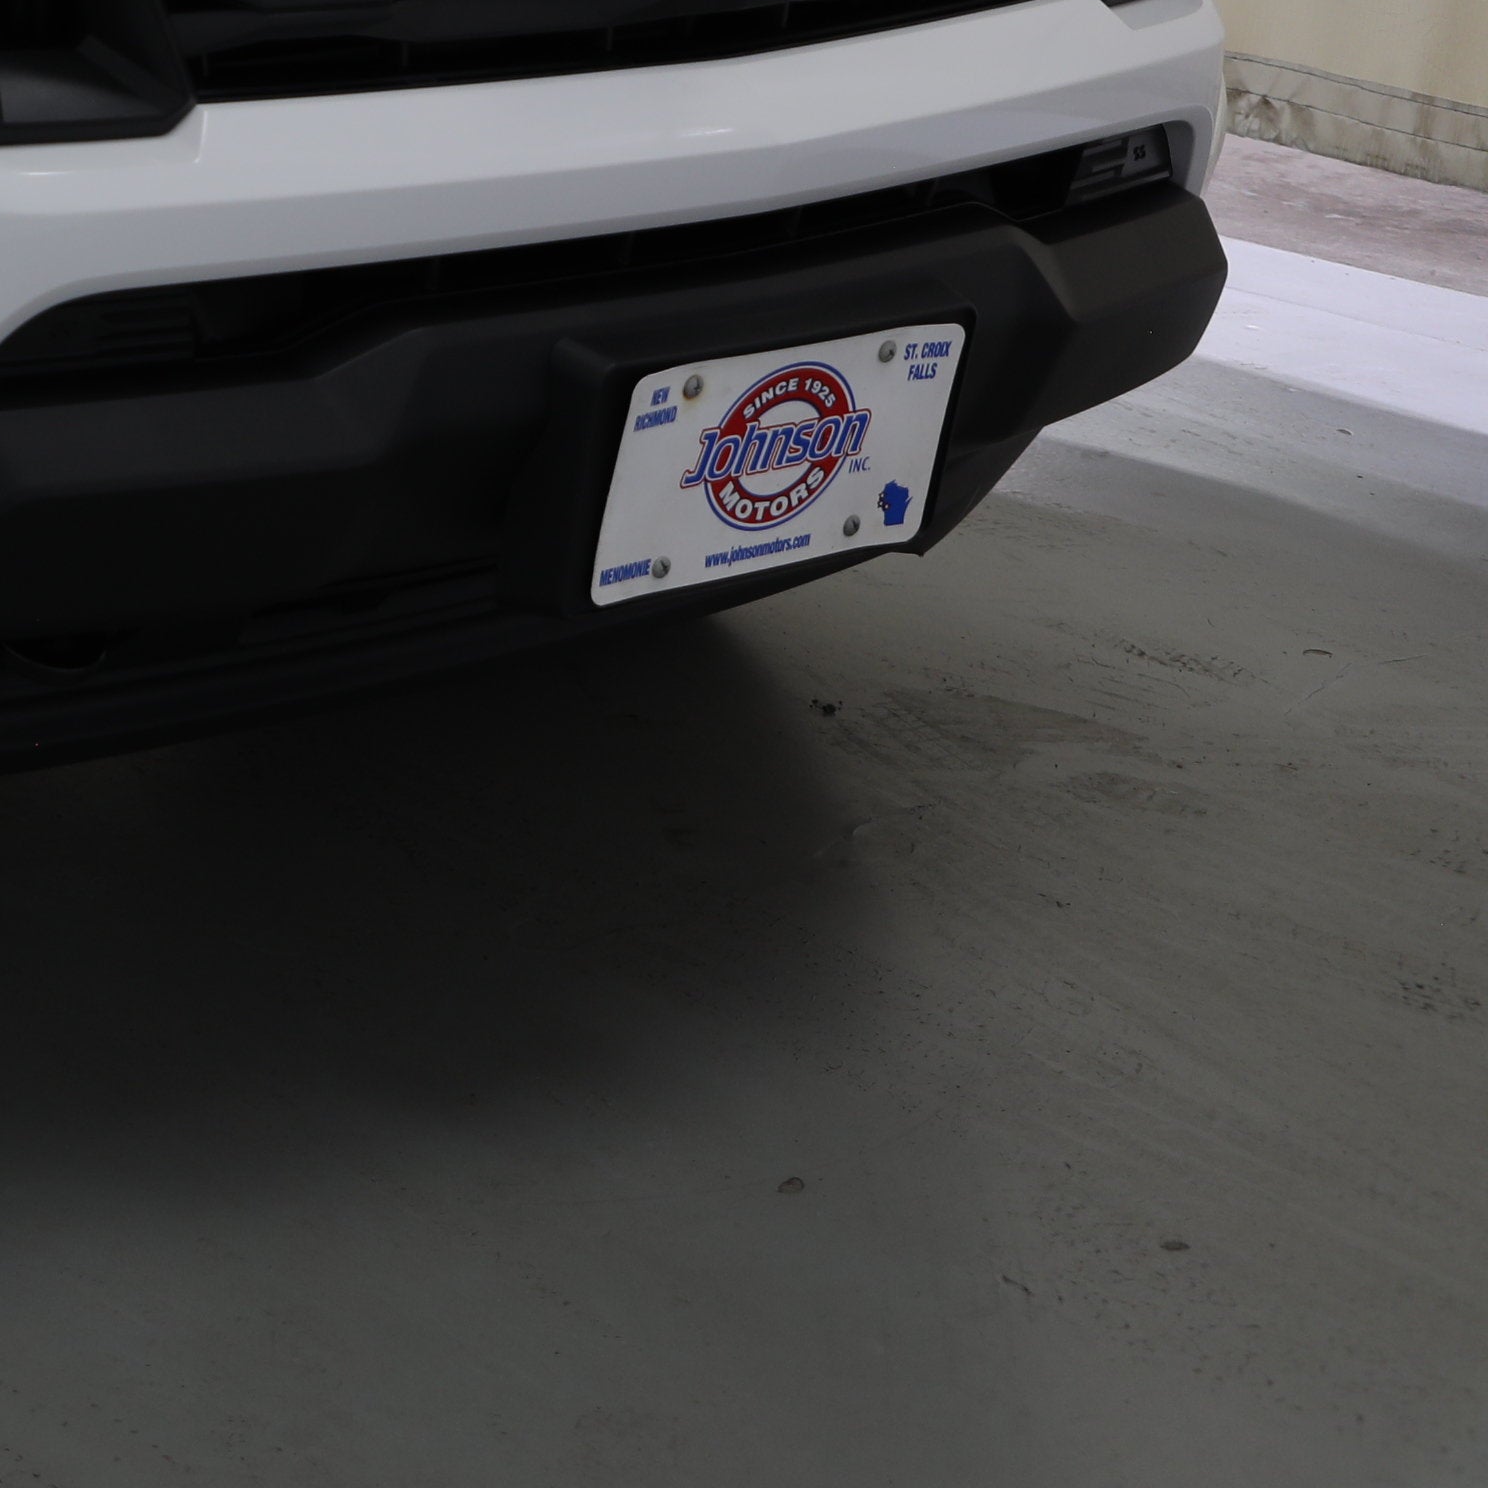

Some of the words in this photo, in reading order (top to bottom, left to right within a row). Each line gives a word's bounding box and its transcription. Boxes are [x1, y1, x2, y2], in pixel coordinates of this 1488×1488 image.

[904, 343, 919, 361] ST.
[920, 340, 953, 359] CROIX
[907, 362, 938, 382] FALLS
[743, 377, 800, 420] SINCE
[804, 378, 837, 408] 1925
[633, 405, 678, 433] RICHMOND
[680, 407, 872, 489] Johnson
[848, 456, 871, 474] INC.
[718, 465, 825, 522] MOTORS
[705, 533, 811, 568] www.johnsonmotors.com
[599, 559, 651, 587] MENOMONIE
